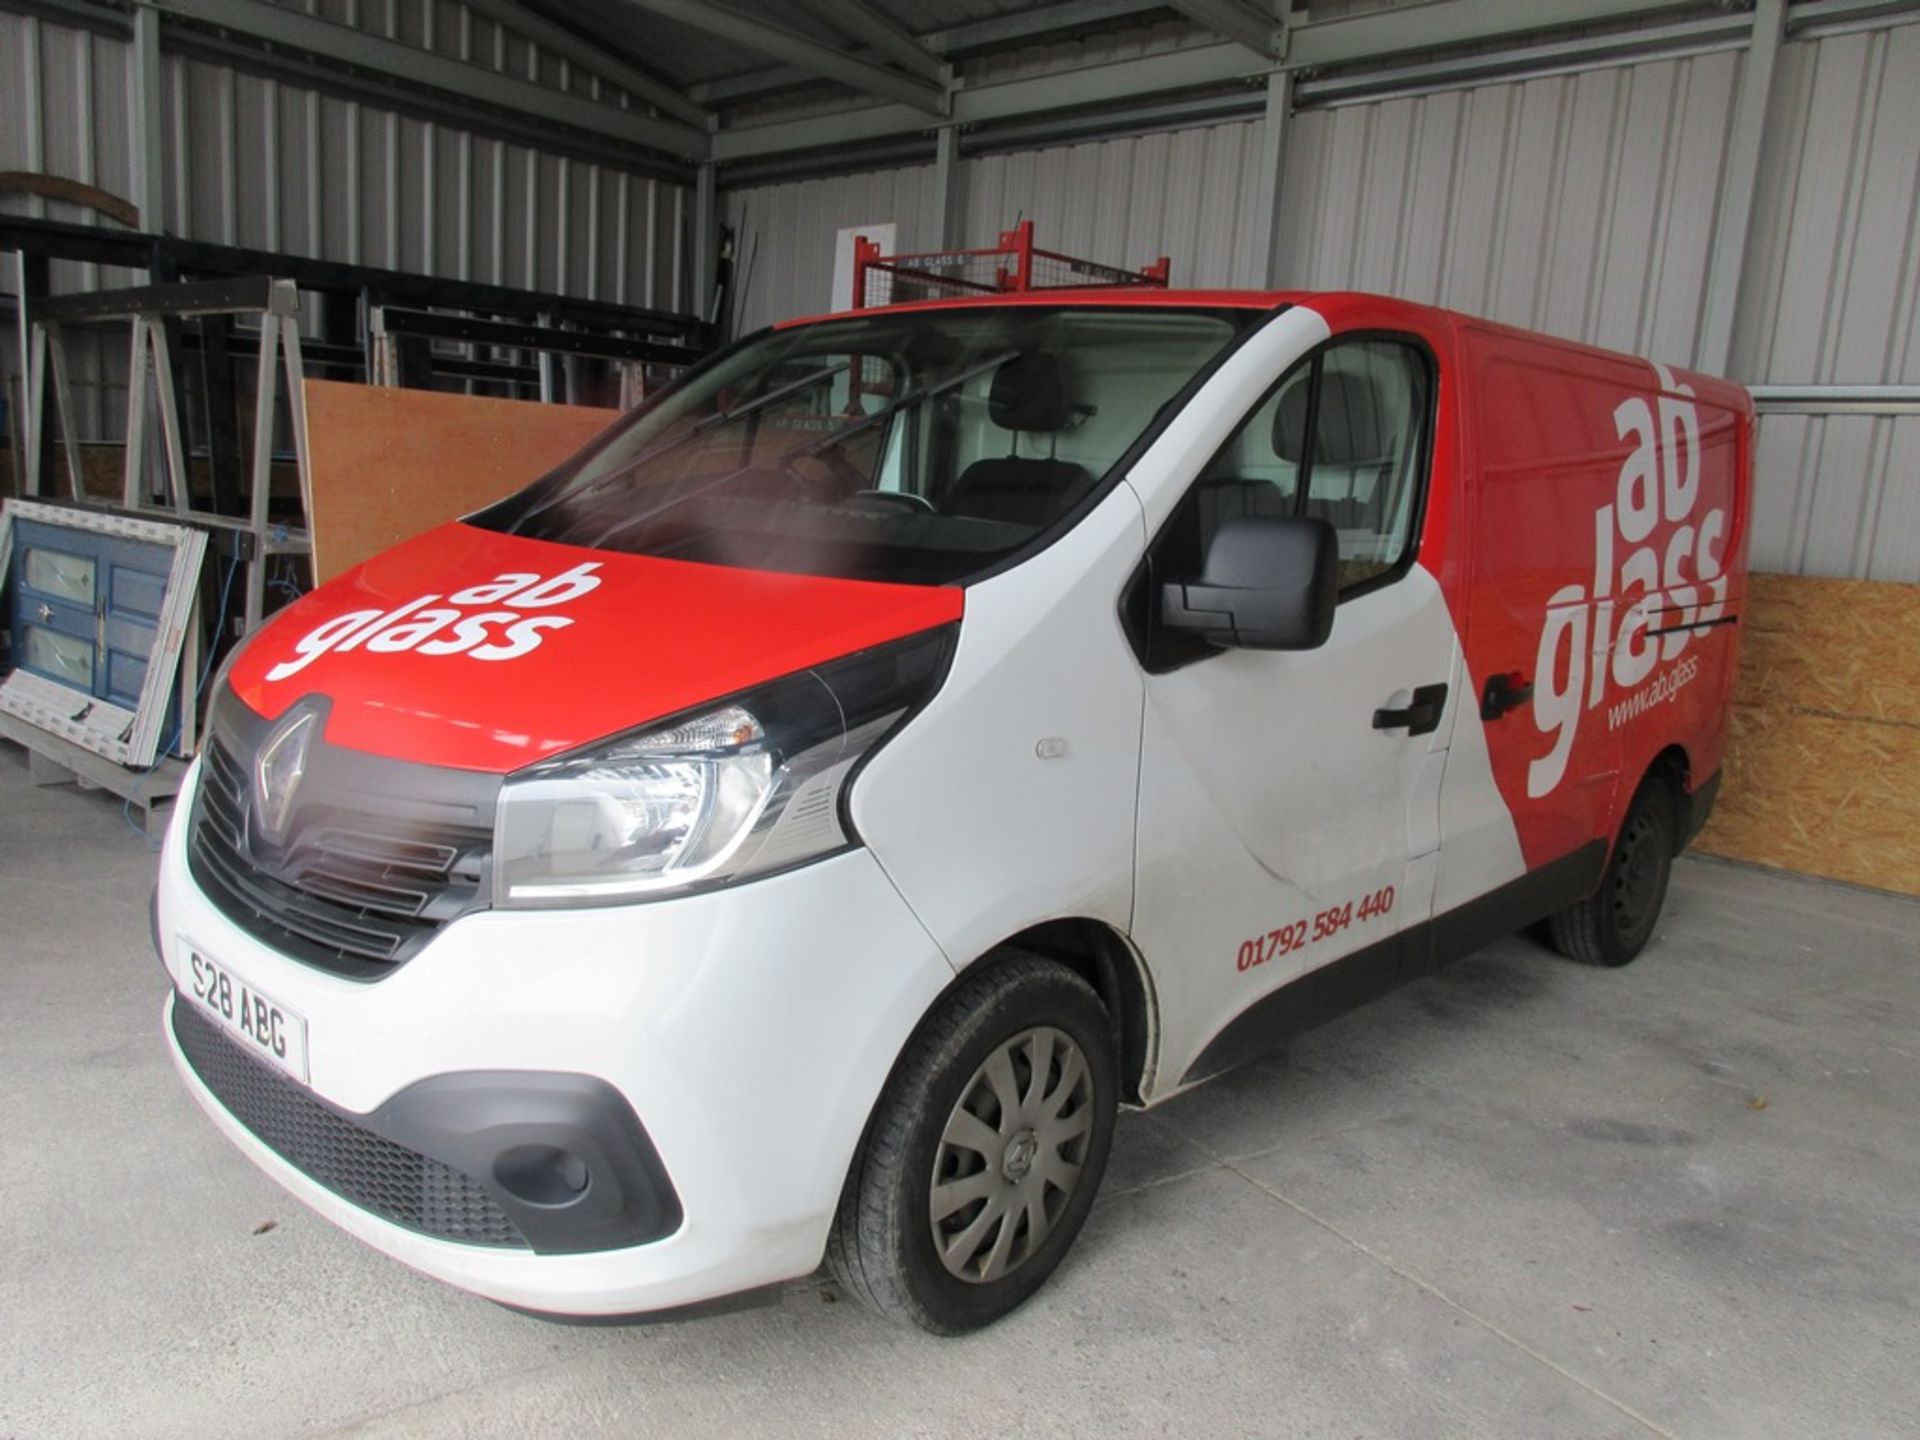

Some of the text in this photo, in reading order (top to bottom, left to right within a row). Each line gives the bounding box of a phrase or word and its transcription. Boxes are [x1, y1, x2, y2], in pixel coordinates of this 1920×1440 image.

[1613, 357, 1700, 543] ab
[448, 562, 604, 608] ab
[264, 594, 575, 681] glass
[1528, 504, 1727, 798] glass
[1608, 654, 1698, 731] www.ab.glass
[1236, 885, 1395, 972] 01792 584 440
[190, 952, 287, 1059] S28 ABG
